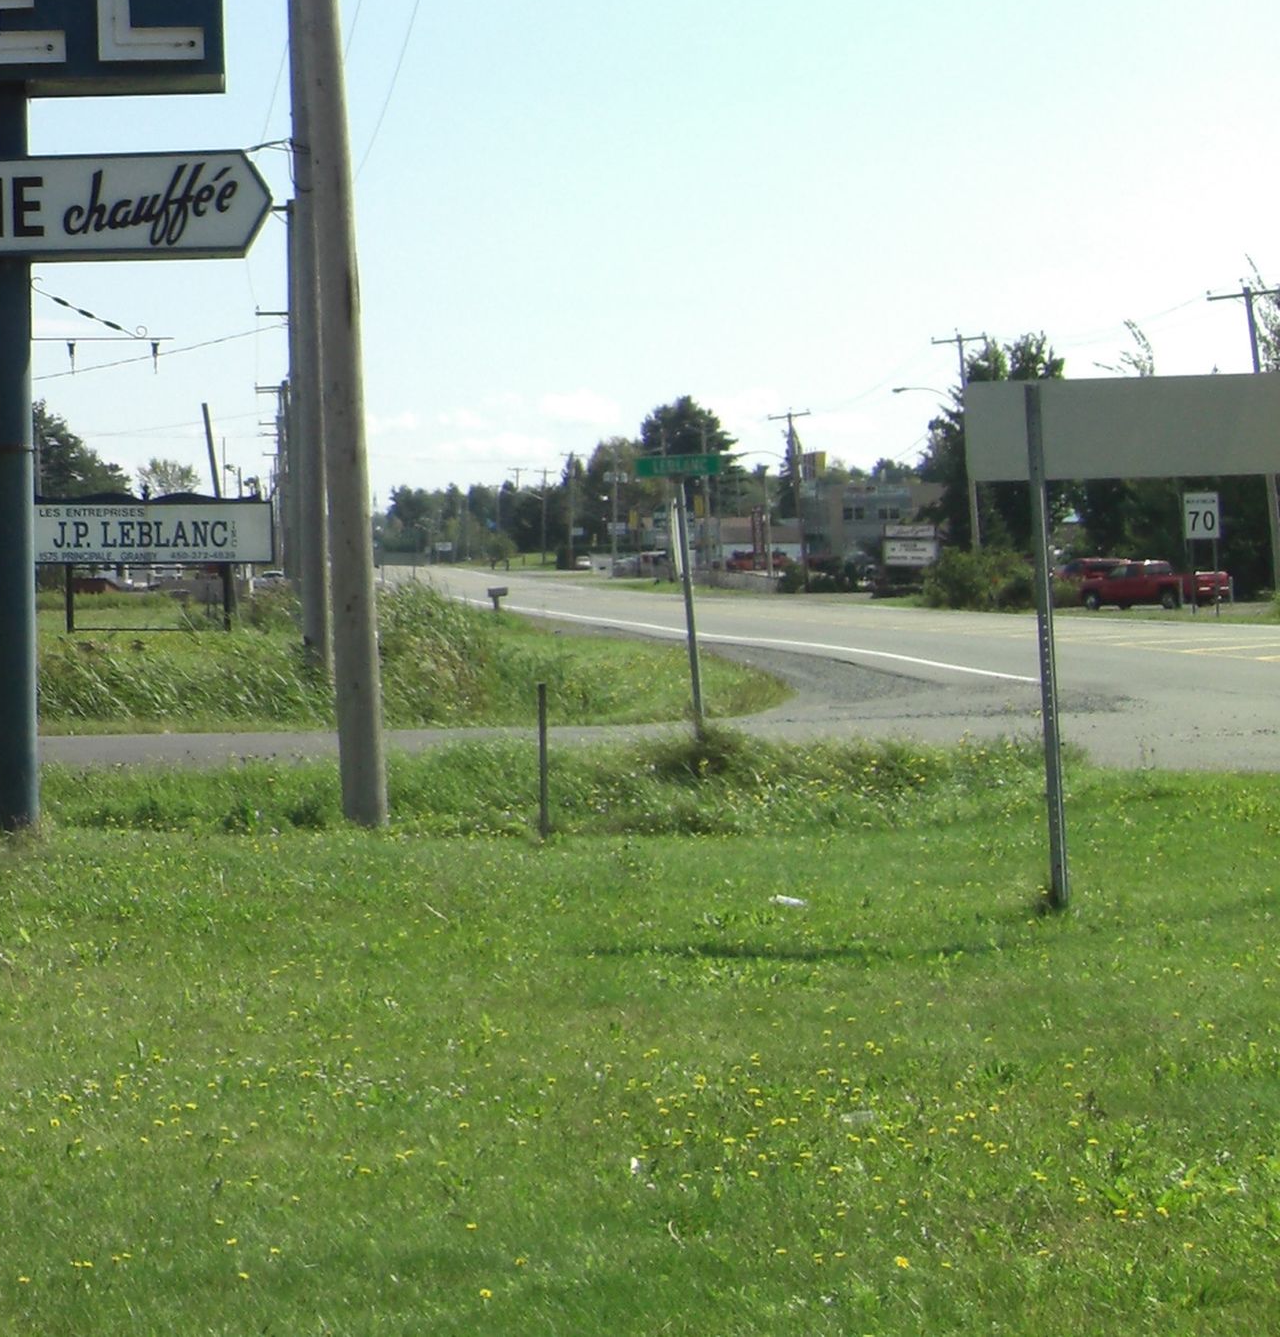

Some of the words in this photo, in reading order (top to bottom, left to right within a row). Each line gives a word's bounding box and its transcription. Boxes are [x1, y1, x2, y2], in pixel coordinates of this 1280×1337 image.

[63, 162, 238, 246] chauffée
[40, 508, 60, 517] LES
[66, 508, 145, 517] ENTREPRISES
[1188, 510, 1215, 531] 70
[53, 521, 90, 548] J.P.
[101, 520, 228, 548] LEBLANC
